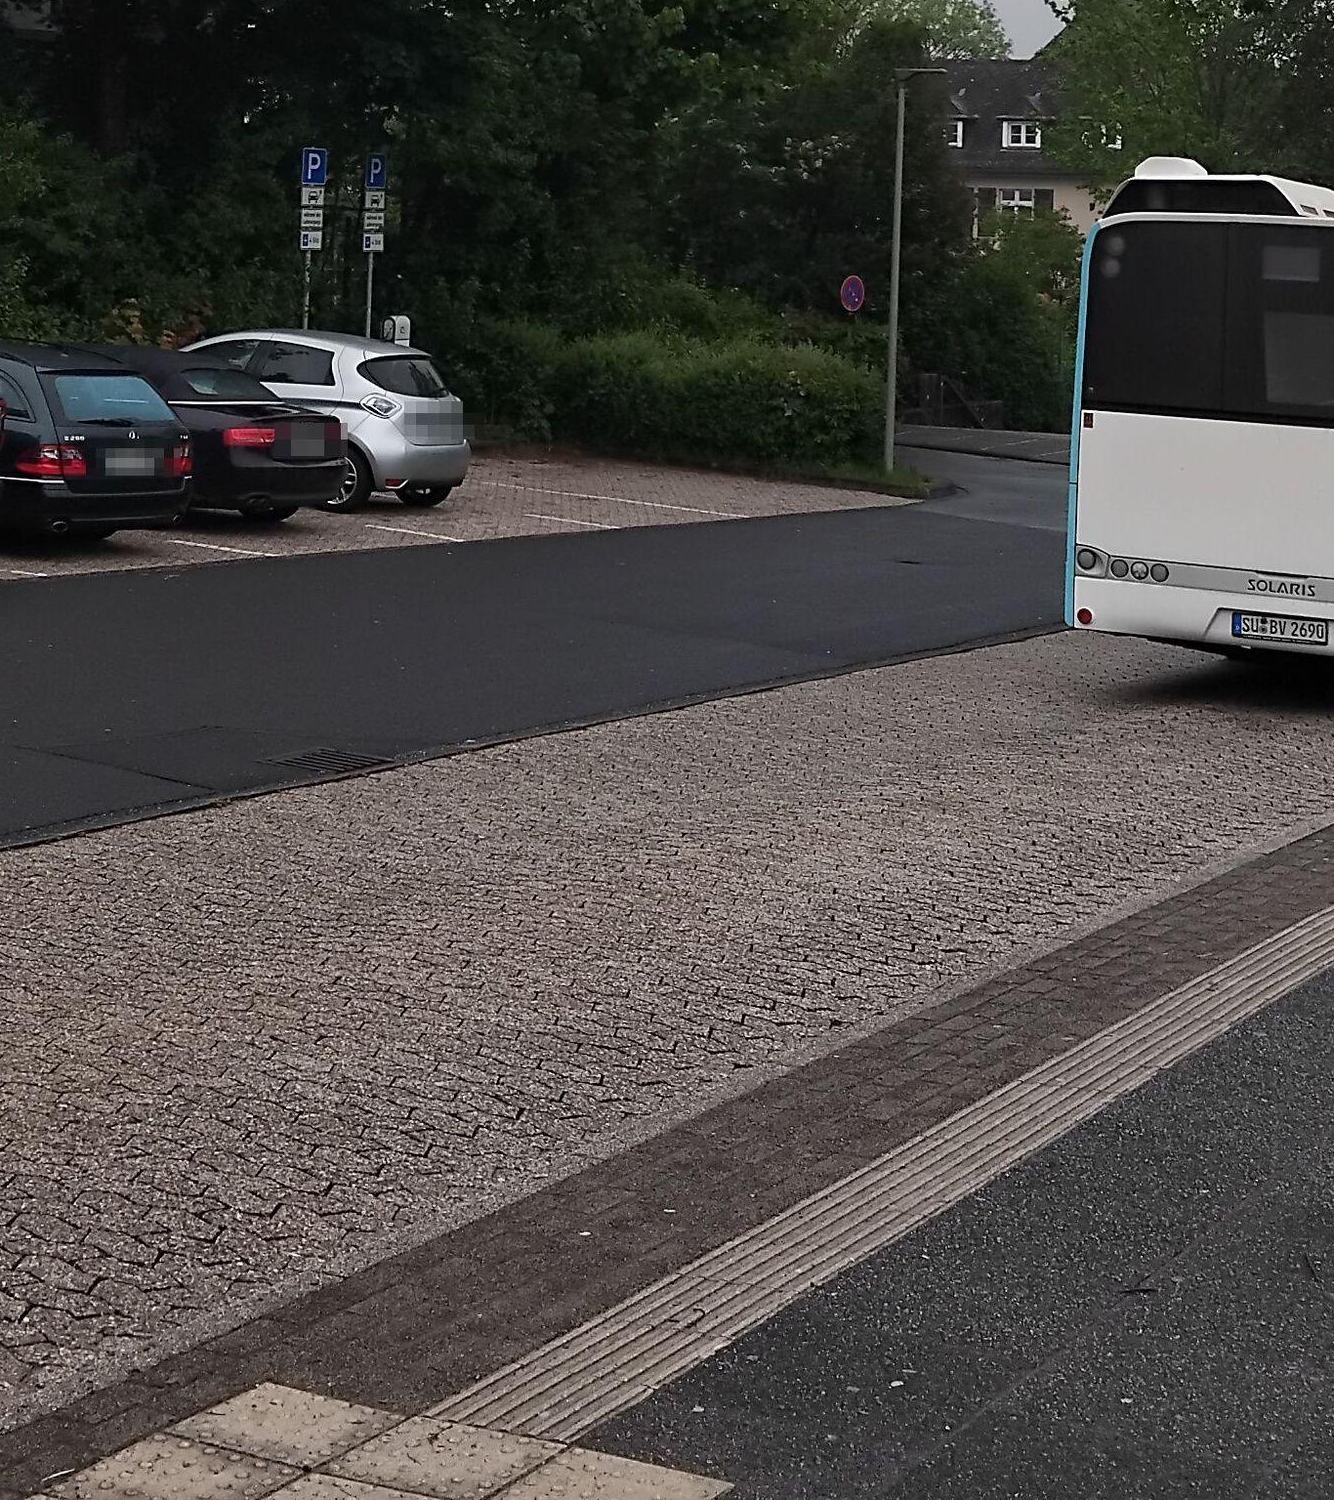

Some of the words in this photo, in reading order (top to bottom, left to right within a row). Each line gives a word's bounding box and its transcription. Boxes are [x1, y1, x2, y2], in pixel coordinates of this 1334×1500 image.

[308, 153, 321, 179] P
[370, 158, 382, 183] P
[1247, 579, 1316, 597] SOLARIS
[1242, 617, 1259, 633] SU
[1270, 619, 1287, 636] BV
[1291, 621, 1324, 639] 2690
